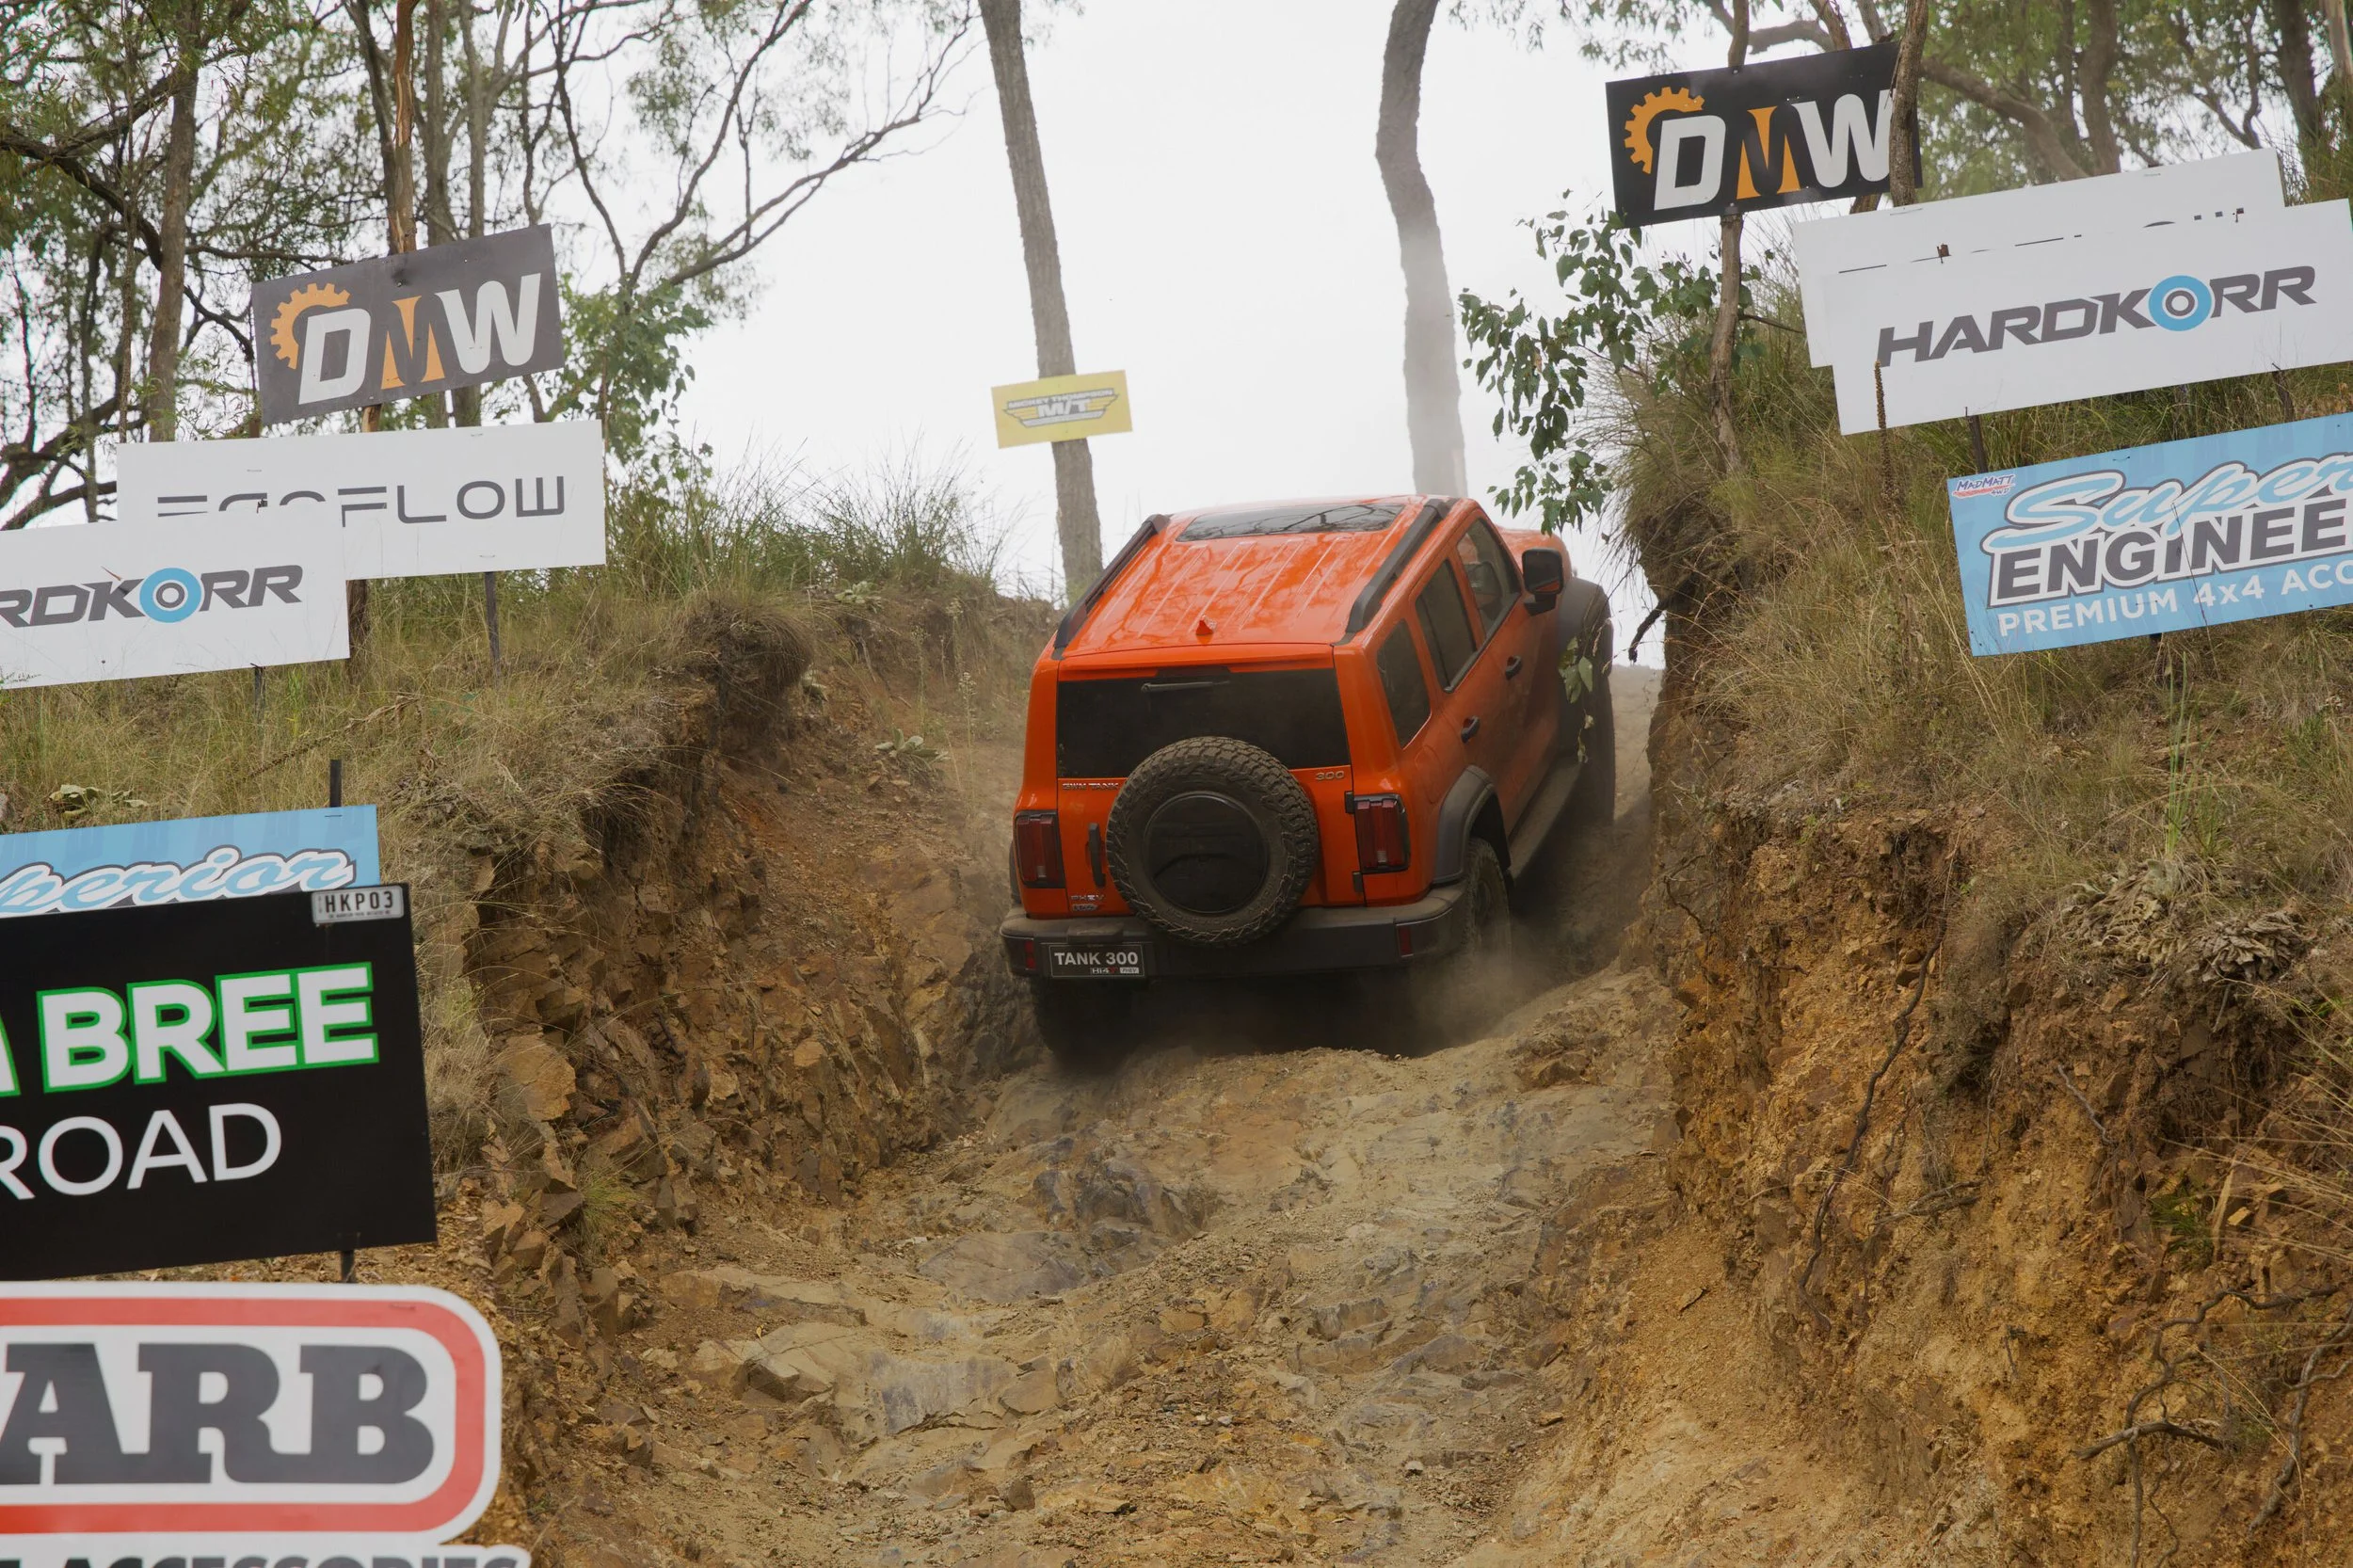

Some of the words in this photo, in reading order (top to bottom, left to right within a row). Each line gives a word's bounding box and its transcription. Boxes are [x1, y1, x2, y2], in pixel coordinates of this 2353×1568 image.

[1653, 88, 1896, 211] DMW
[298, 272, 541, 405] DMW
[1878, 264, 2317, 367] HARDKORR
[1998, 587, 2179, 637] PREMIUM
[2193, 574, 2265, 608] 4x4
[1315, 770, 1345, 780] 300
[1054, 952, 1101, 966] TANK
[1105, 952, 1139, 966] 300
[37, 961, 379, 1094] BREE
[0, 1343, 434, 1484] ARB
